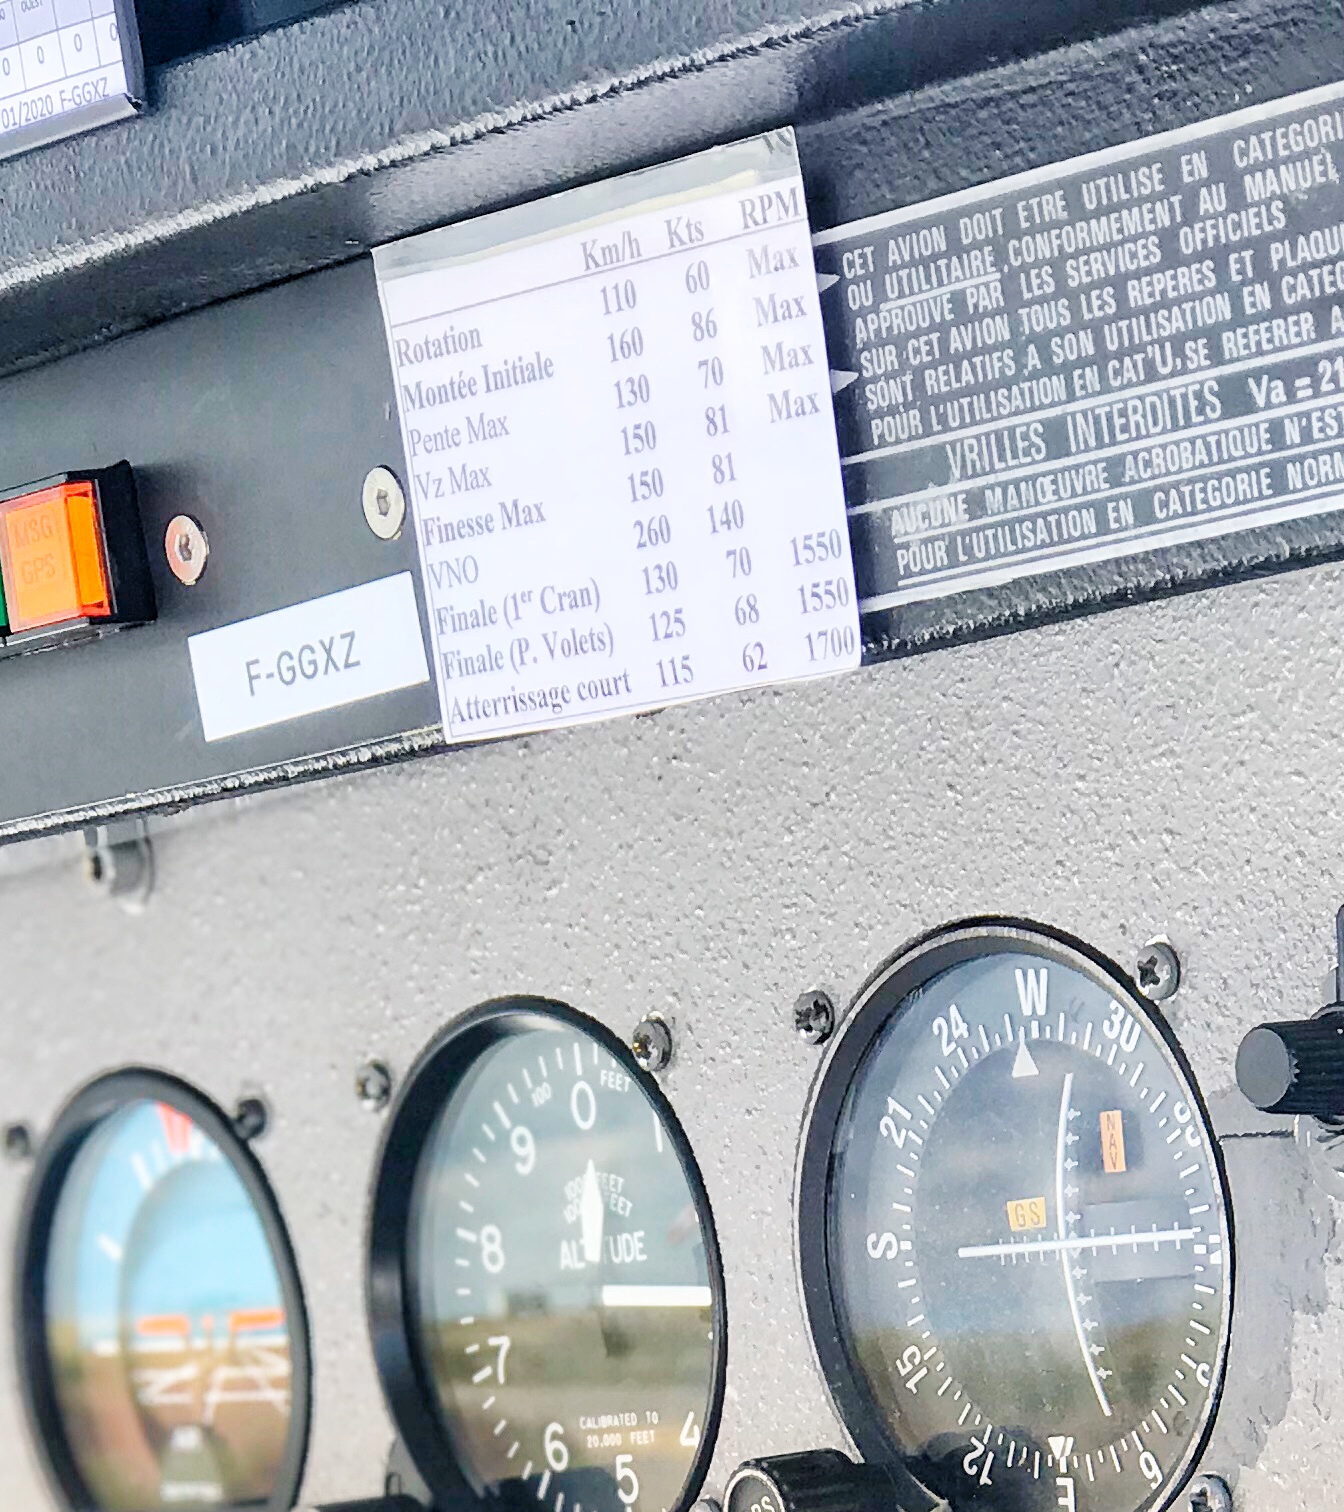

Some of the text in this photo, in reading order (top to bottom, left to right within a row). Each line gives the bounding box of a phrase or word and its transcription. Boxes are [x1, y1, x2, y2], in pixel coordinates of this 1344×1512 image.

[59, 77, 109, 111] F-GGXZ
[582, 186, 801, 273] Km/h Kts RPM
[842, 246, 875, 280] CET
[888, 225, 947, 268] AVION
[960, 207, 1004, 245] DOIT
[1017, 191, 1068, 229] ETRE
[1082, 162, 1165, 211] UTILISE
[1180, 150, 1208, 182] EN
[396, 244, 800, 367] Rotation 110 60 Max
[402, 293, 807, 413] Montée Initiale 160 86 Max
[945, 379, 1221, 483] VRILLES INTERDITES
[246, 630, 360, 696] F-GGXZ
[449, 625, 855, 724] Atterrissage court 115 62 1700
[1014, 969, 1048, 1016] W
[480, 1225, 505, 1274] 8
[615, 1455, 639, 1503] 5
